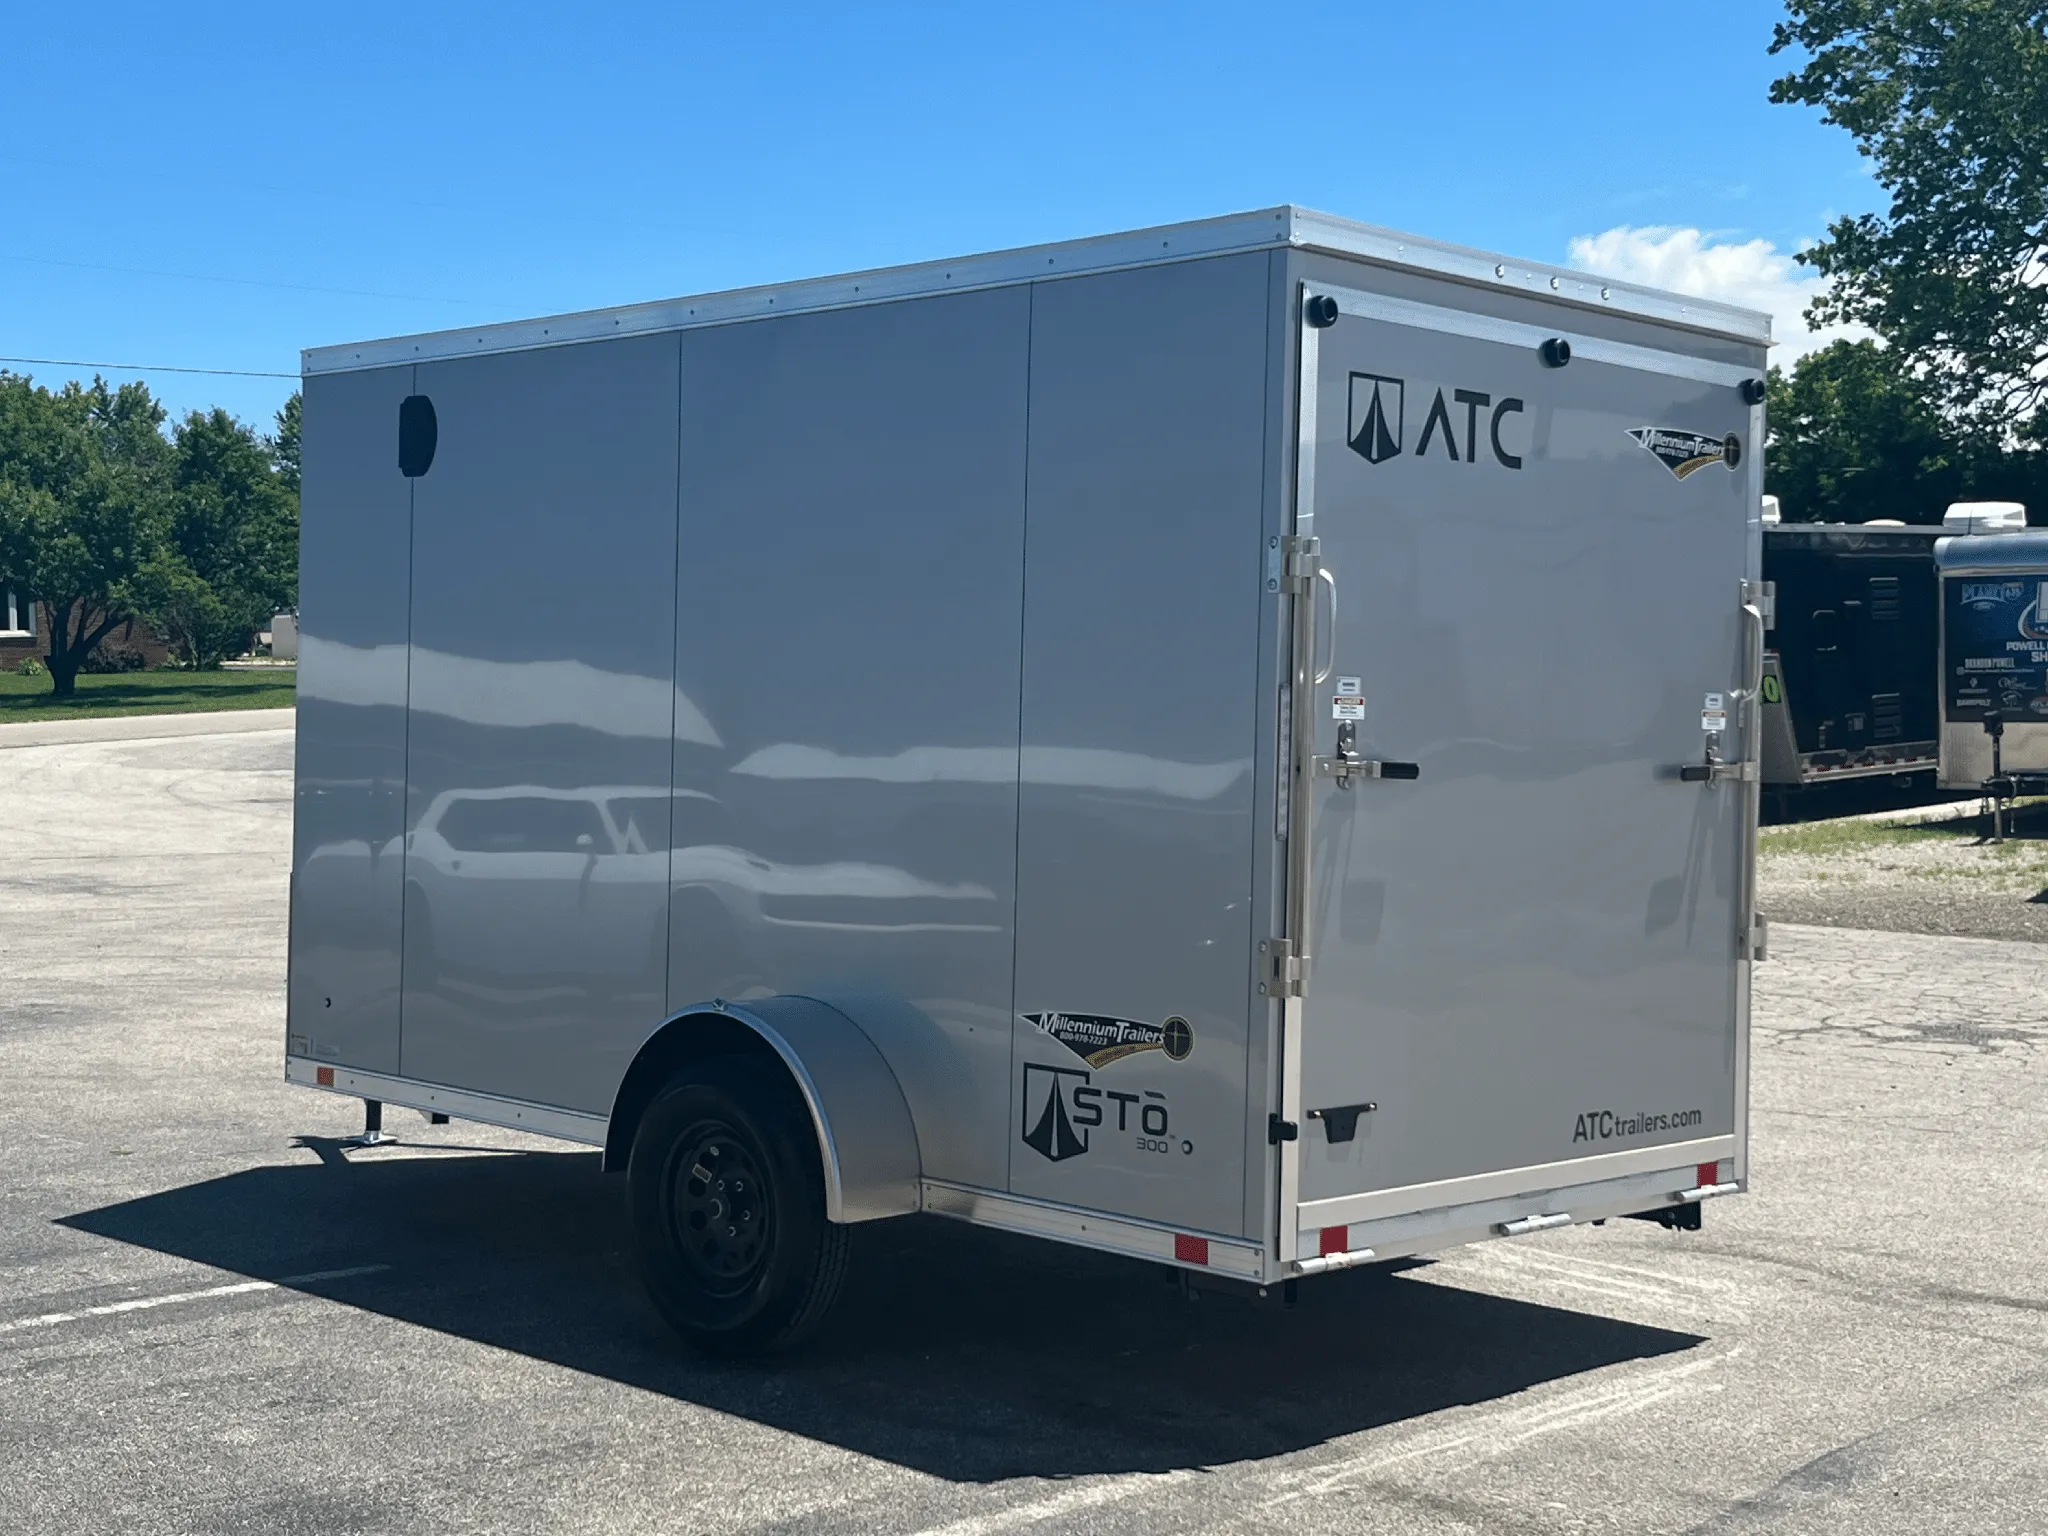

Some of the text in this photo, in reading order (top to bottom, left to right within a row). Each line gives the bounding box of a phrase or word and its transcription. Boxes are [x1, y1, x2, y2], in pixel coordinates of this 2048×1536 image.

[1415, 387, 1523, 470] ATC
[2006, 641, 2046, 651] POWELL
[1136, 1137, 1169, 1154] 300
